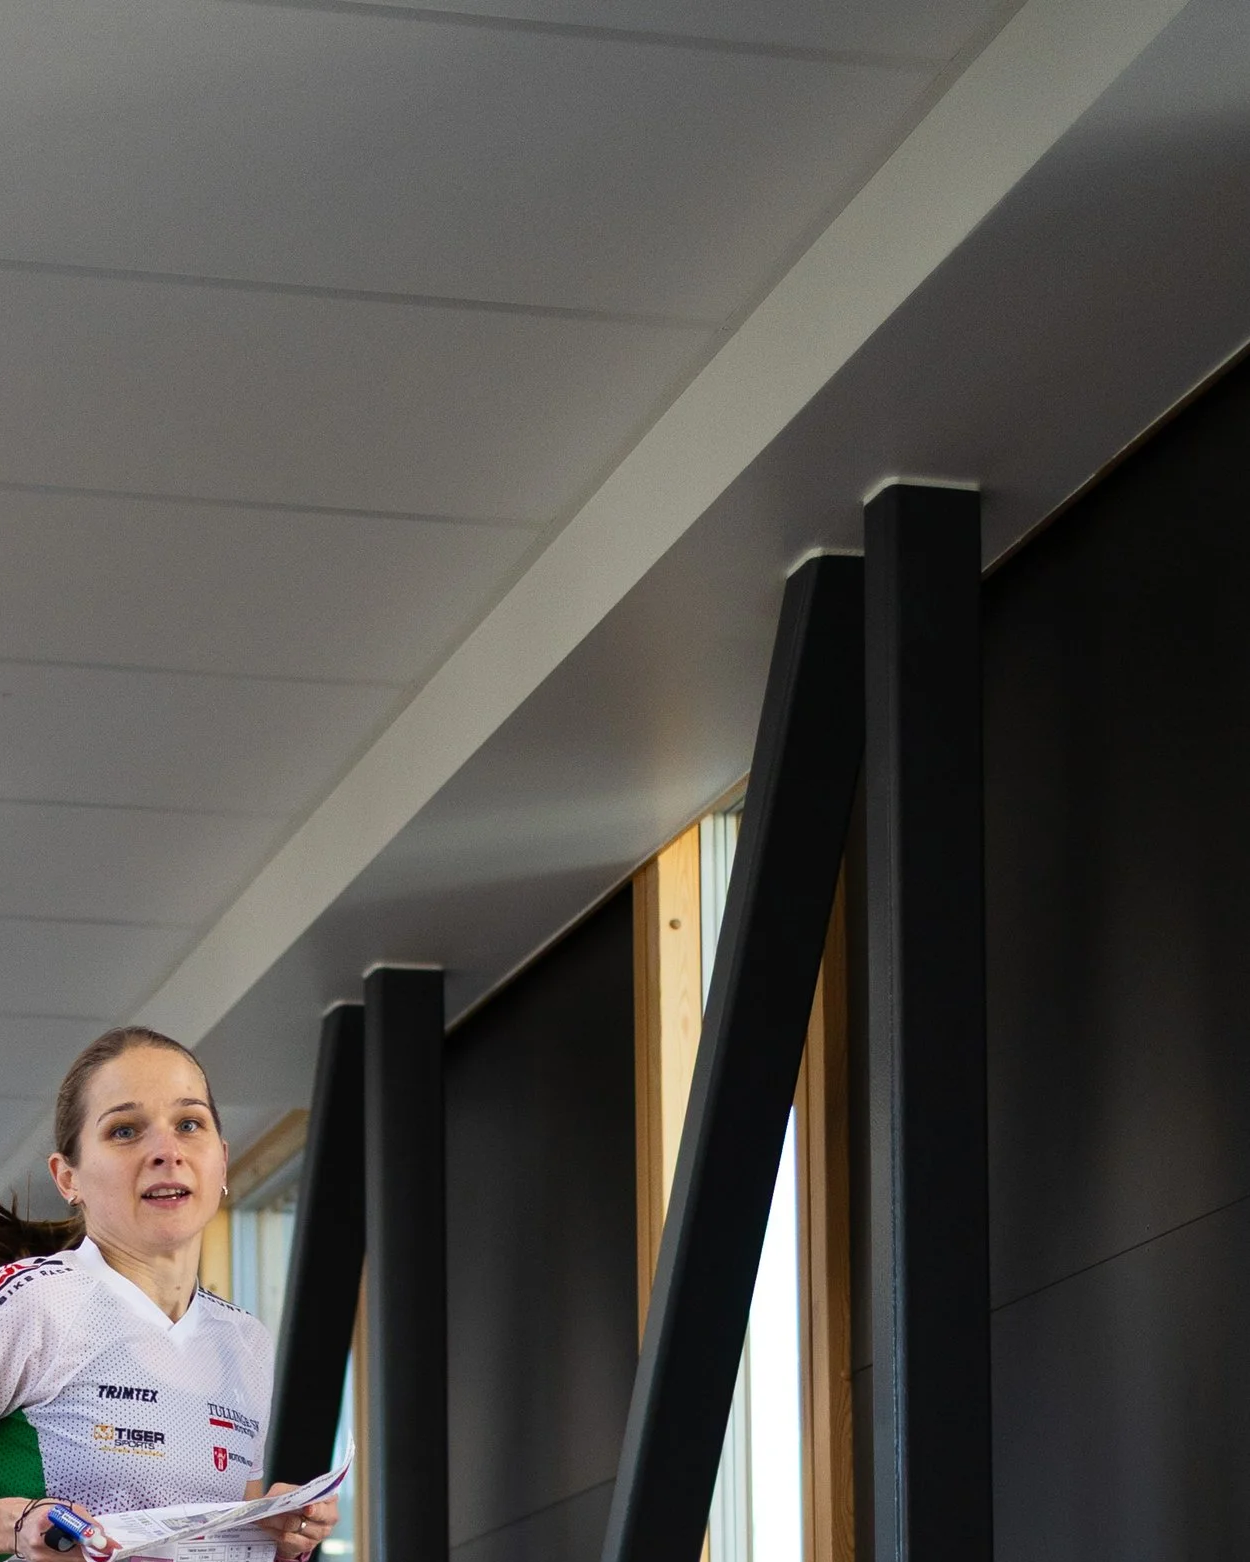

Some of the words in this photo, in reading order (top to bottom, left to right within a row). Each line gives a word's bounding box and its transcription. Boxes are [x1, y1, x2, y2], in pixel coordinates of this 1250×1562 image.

[98, 1385, 159, 1403] TRIMTEX
[114, 1427, 165, 1444] TIGER
[114, 1439, 155, 1450] SPORTS
